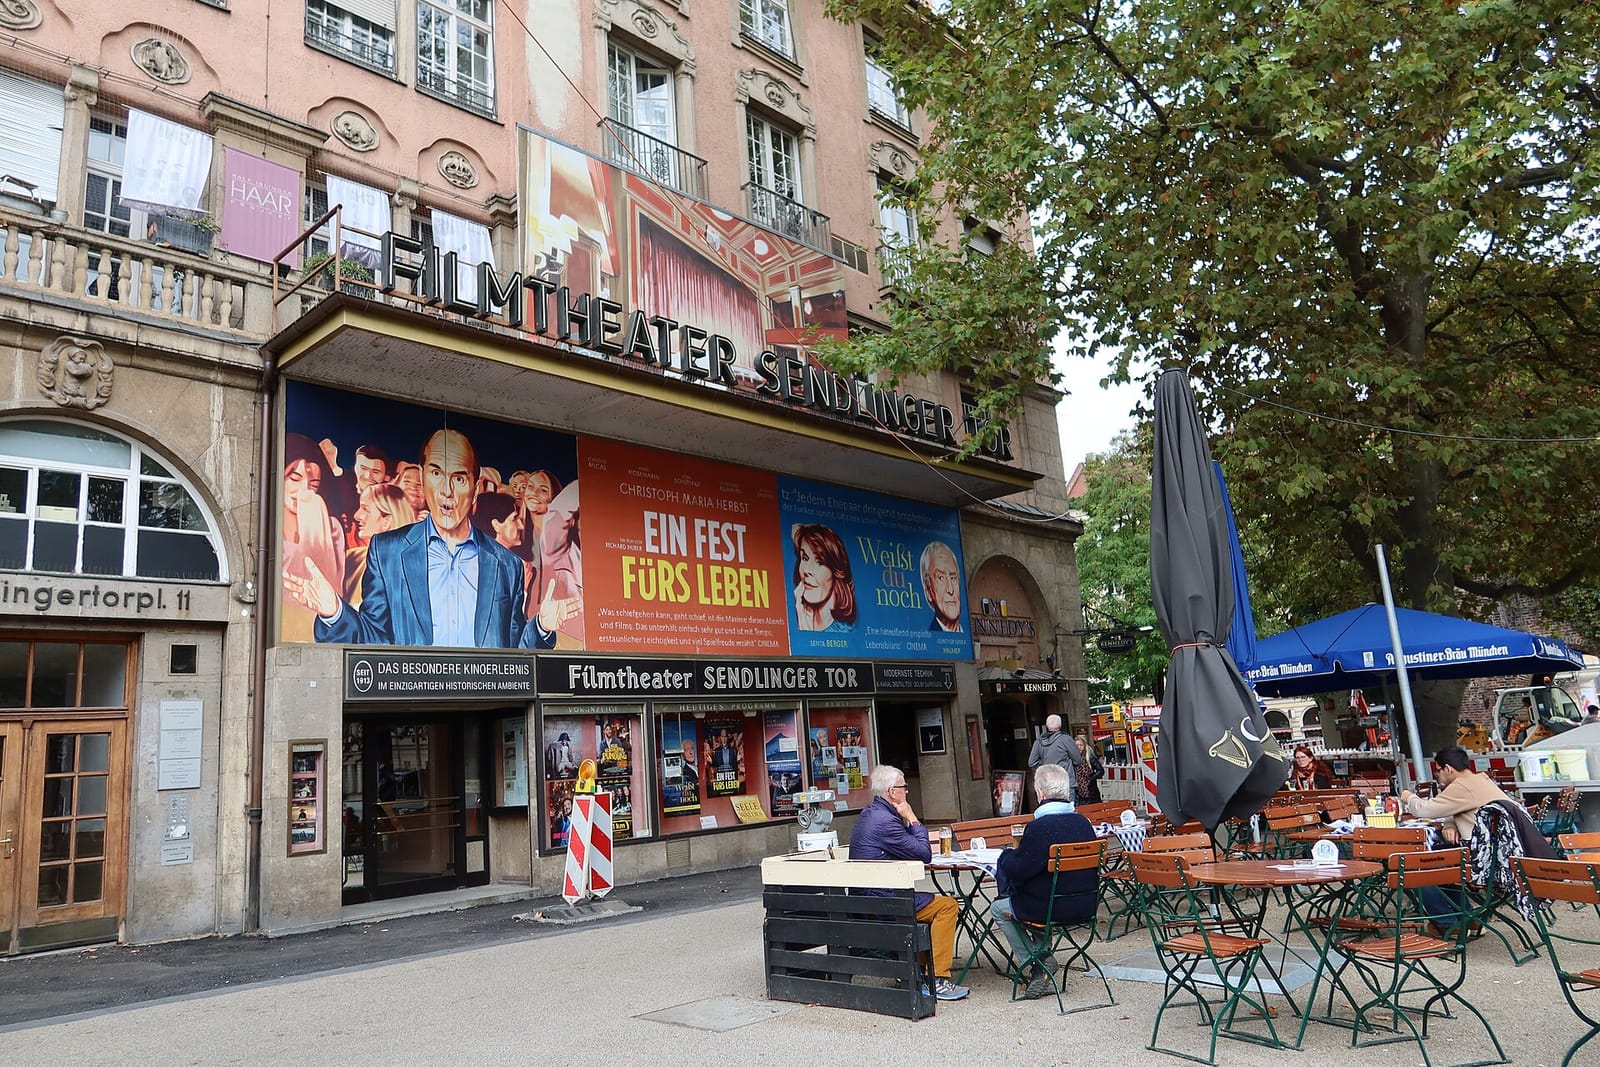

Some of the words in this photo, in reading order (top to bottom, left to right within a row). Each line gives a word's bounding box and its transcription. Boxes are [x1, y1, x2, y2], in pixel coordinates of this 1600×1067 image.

[231, 180, 292, 215] HAAR
[381, 229, 738, 387] FILMTHEATER
[754, 350, 957, 444] SENDLINGER
[619, 482, 679, 503] CHRISTOPH
[682, 493, 714, 509] MARIA
[716, 499, 750, 513] HERBST
[643, 511, 688, 557] EIN
[694, 518, 746, 563] FEST
[857, 536, 916, 571] Weißt
[621, 555, 691, 603] FÜRS
[696, 564, 770, 609] LEBEN
[883, 563, 907, 589] du
[3, 580, 167, 613] ingertorpl.
[176, 589, 190, 611] 11
[875, 583, 923, 609] noch
[615, 608, 655, 619] schiefgehen
[673, 611, 687, 621] geht
[599, 621, 614, 630] und
[635, 622, 648, 631] Das
[598, 634, 642, 643] erstaunlicher
[643, 635, 679, 646] Leichtigkeit
[679, 637, 691, 645] und
[826, 639, 848, 648] BERGER
[1467, 645, 1509, 659] München
[378, 662, 399, 674] DAS
[402, 662, 461, 675] BESONDERE
[463, 663, 530, 675] KINOERLEBNIS
[883, 668, 913, 678] MODERNSTE
[1279, 662, 1313, 675] München
[356, 677, 371, 685] 1913
[568, 664, 693, 690] Filmtheater
[703, 666, 818, 690] SENDLINGER
[825, 667, 859, 688] TOR
[378, 681, 387, 690] IM
[389, 681, 444, 691] EINZIGARTIGEN
[445, 681, 496, 690] HISTORISCHEN
[497, 681, 531, 690] AMBIENTE
[679, 703, 725, 712] HEUTIGES
[731, 702, 777, 711] PROGRAMM
[725, 771, 736, 780] FEST
